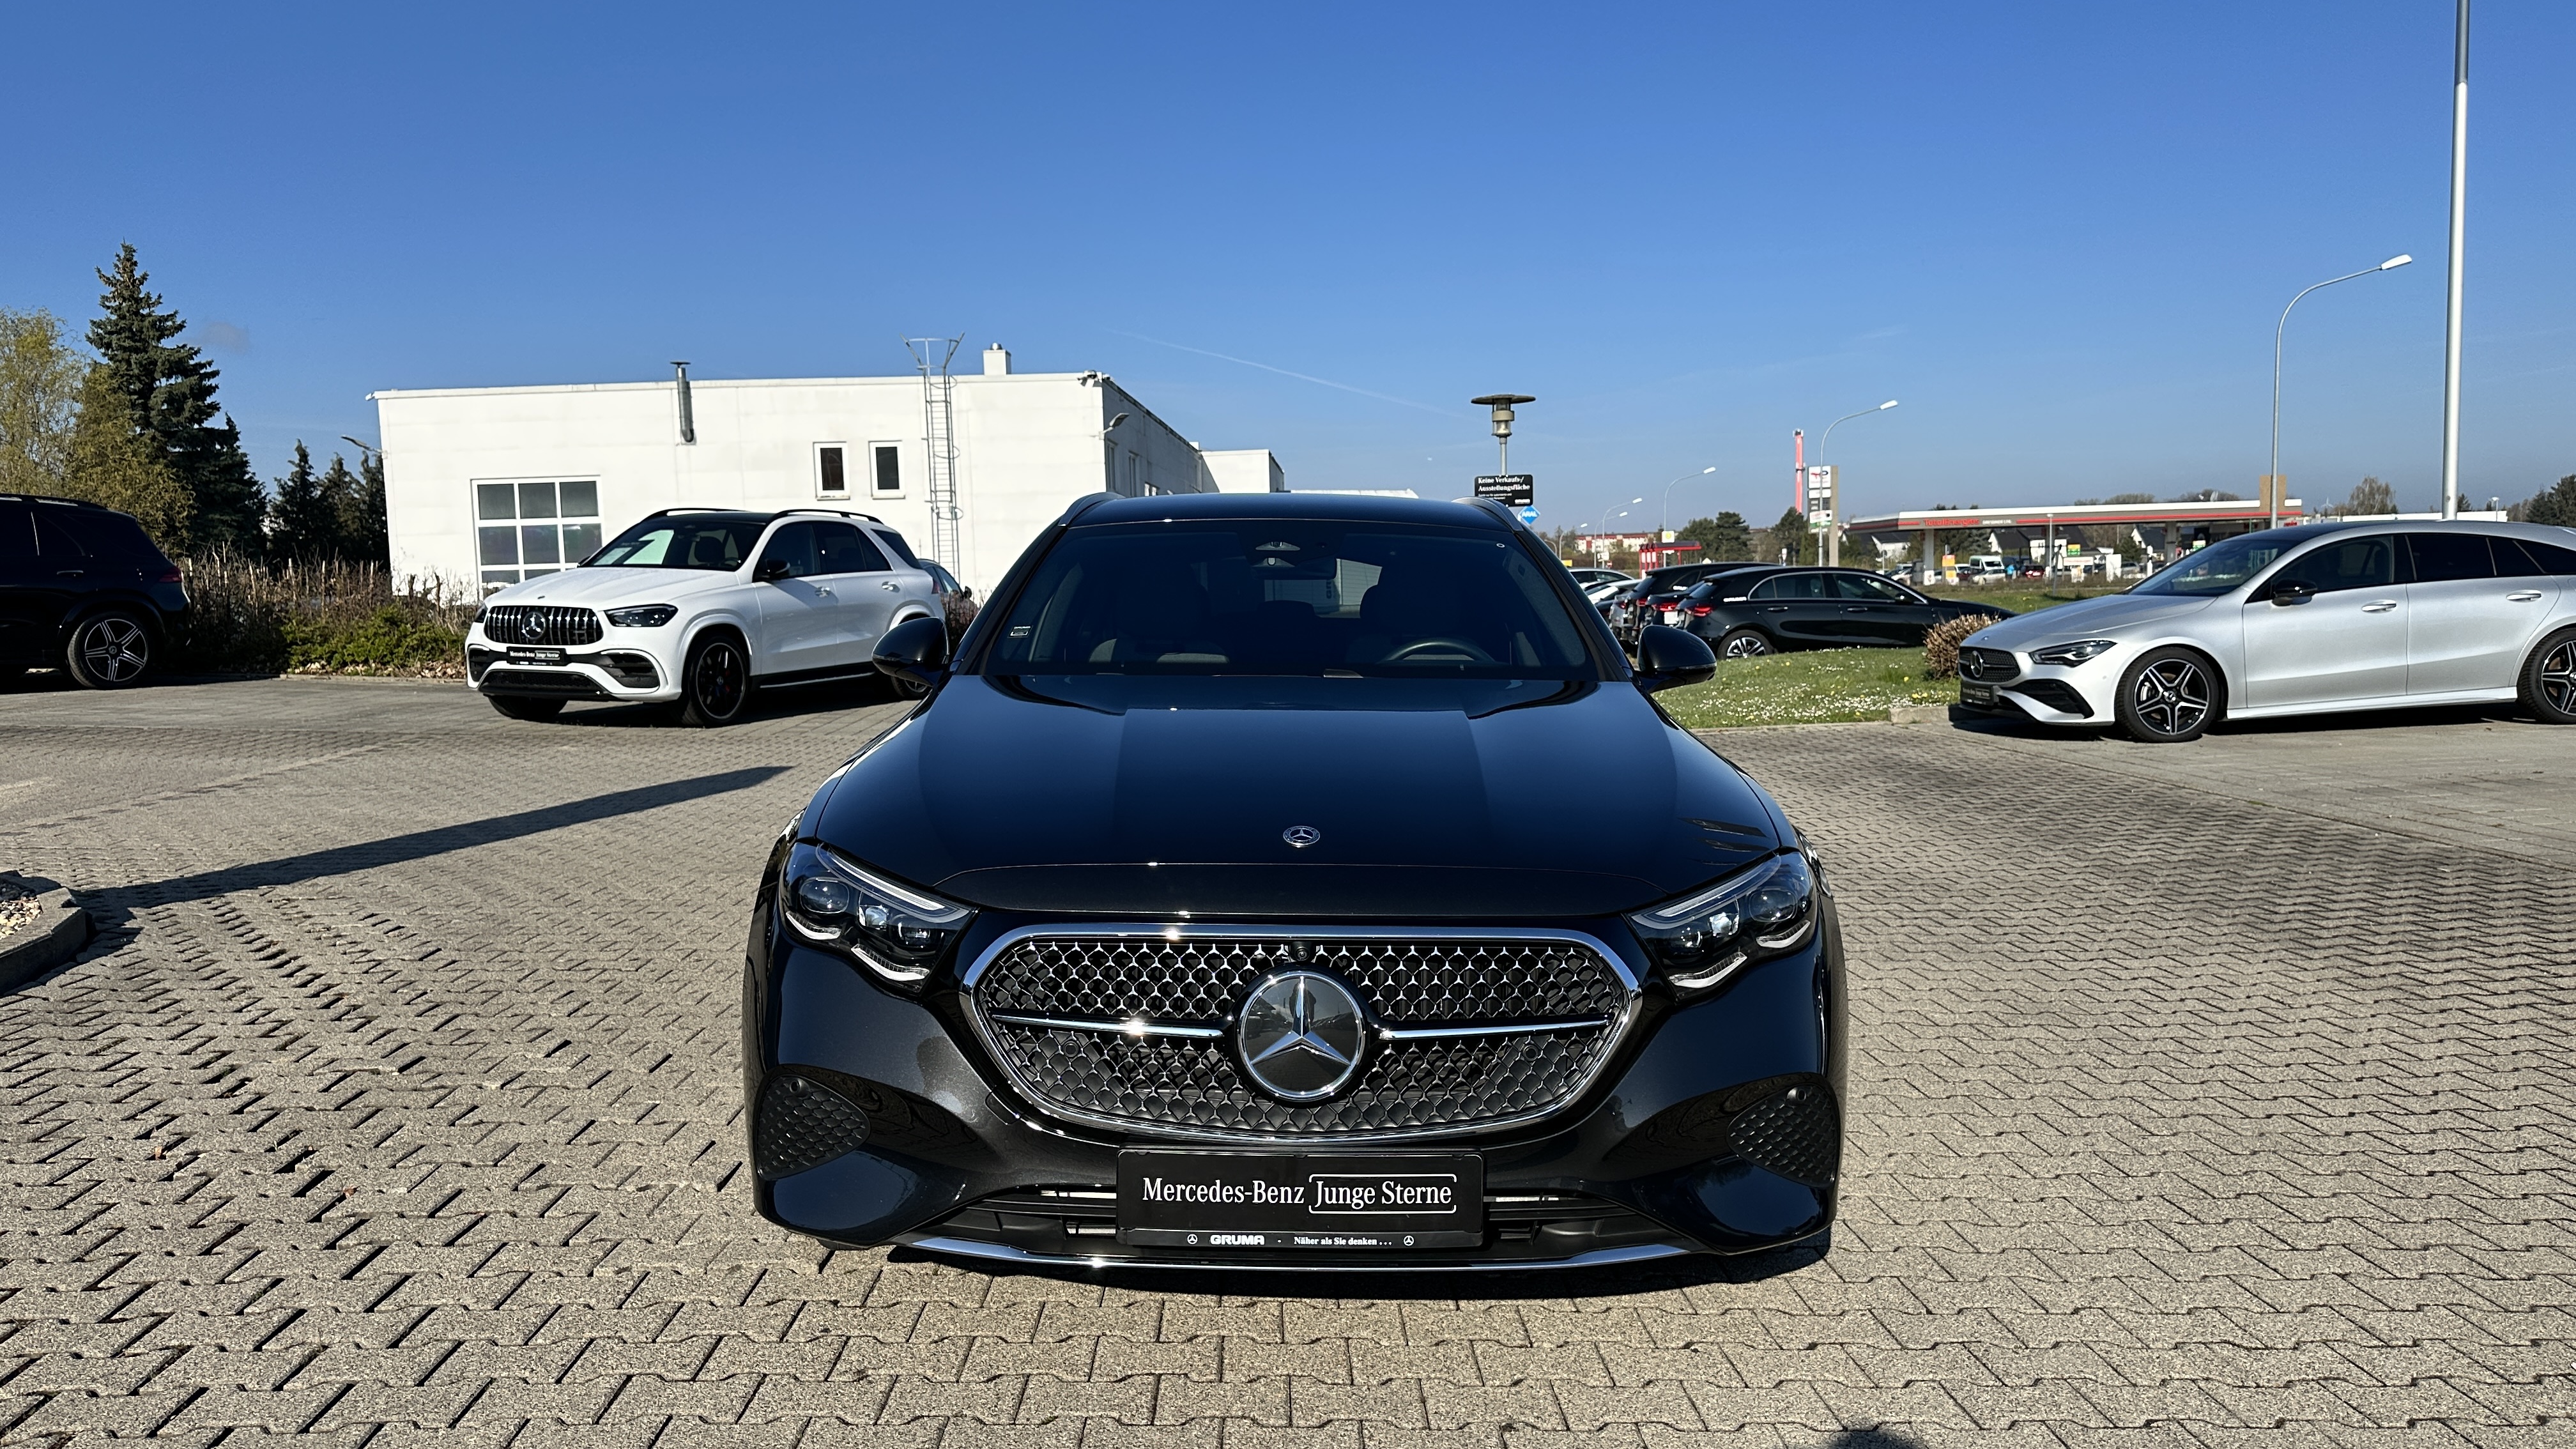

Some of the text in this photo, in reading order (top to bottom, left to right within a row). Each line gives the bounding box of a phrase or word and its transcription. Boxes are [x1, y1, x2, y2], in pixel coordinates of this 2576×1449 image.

[1142, 1177, 1305, 1204] Mercedes-Benz
[1314, 1181, 1452, 1209] Junge Sterne
[1210, 1234, 1265, 1245] GRUMA
[1294, 1236, 1319, 1245] Näher
[1320, 1237, 1333, 1245] als
[1333, 1237, 1347, 1245] Sie
[1347, 1237, 1377, 1246] denken
